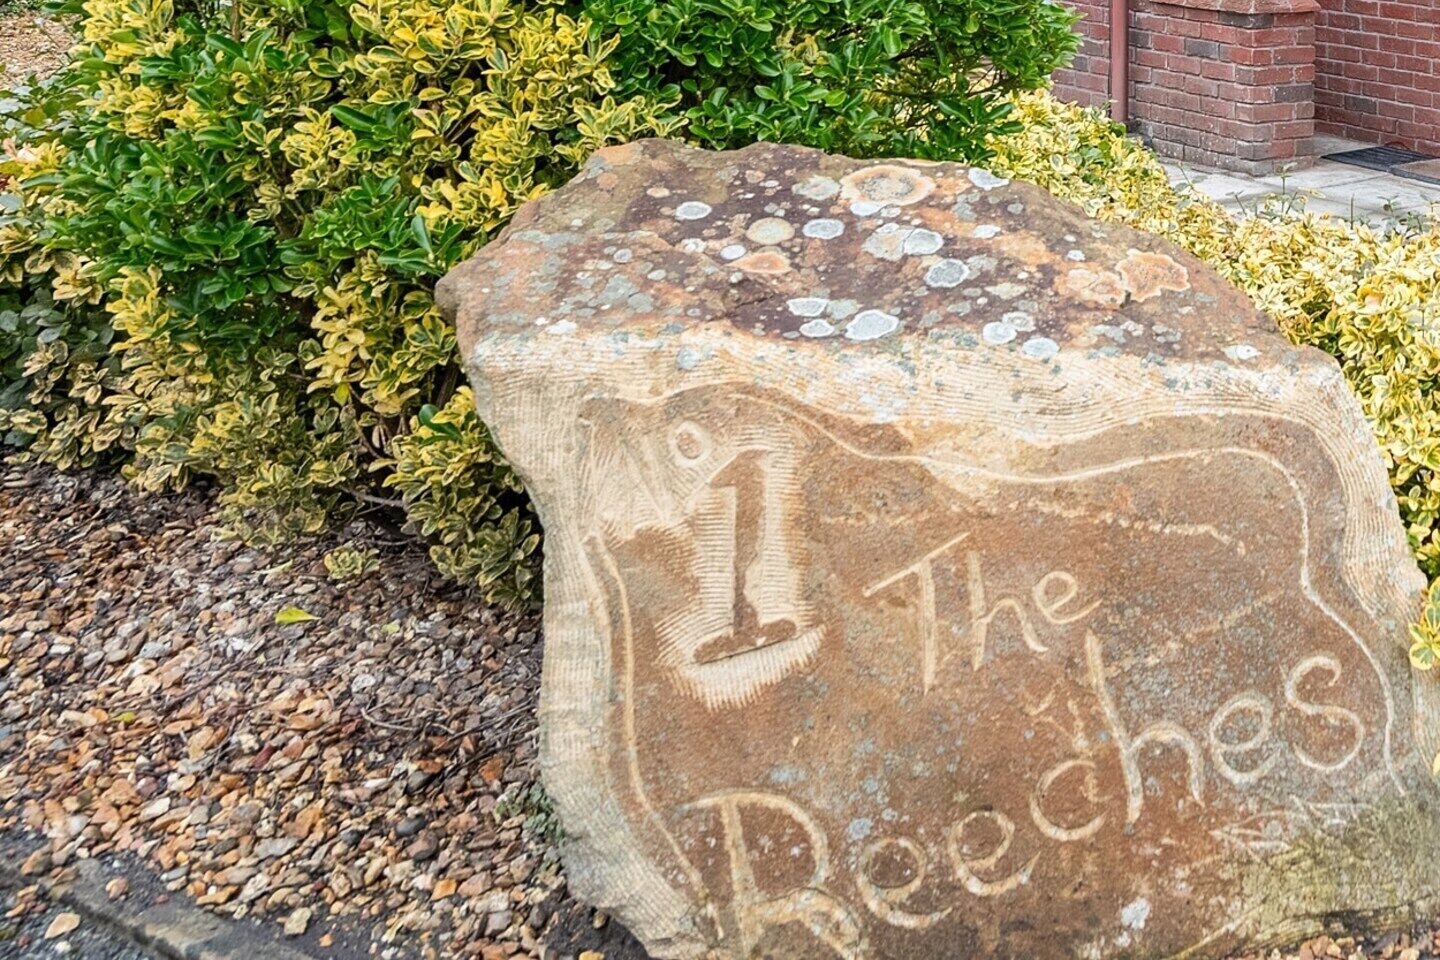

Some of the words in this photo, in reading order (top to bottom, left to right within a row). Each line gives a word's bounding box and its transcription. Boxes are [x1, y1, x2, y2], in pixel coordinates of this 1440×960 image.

[682, 442, 806, 670] 1
[861, 530, 1102, 693] The
[669, 628, 1367, 960] Beeches
